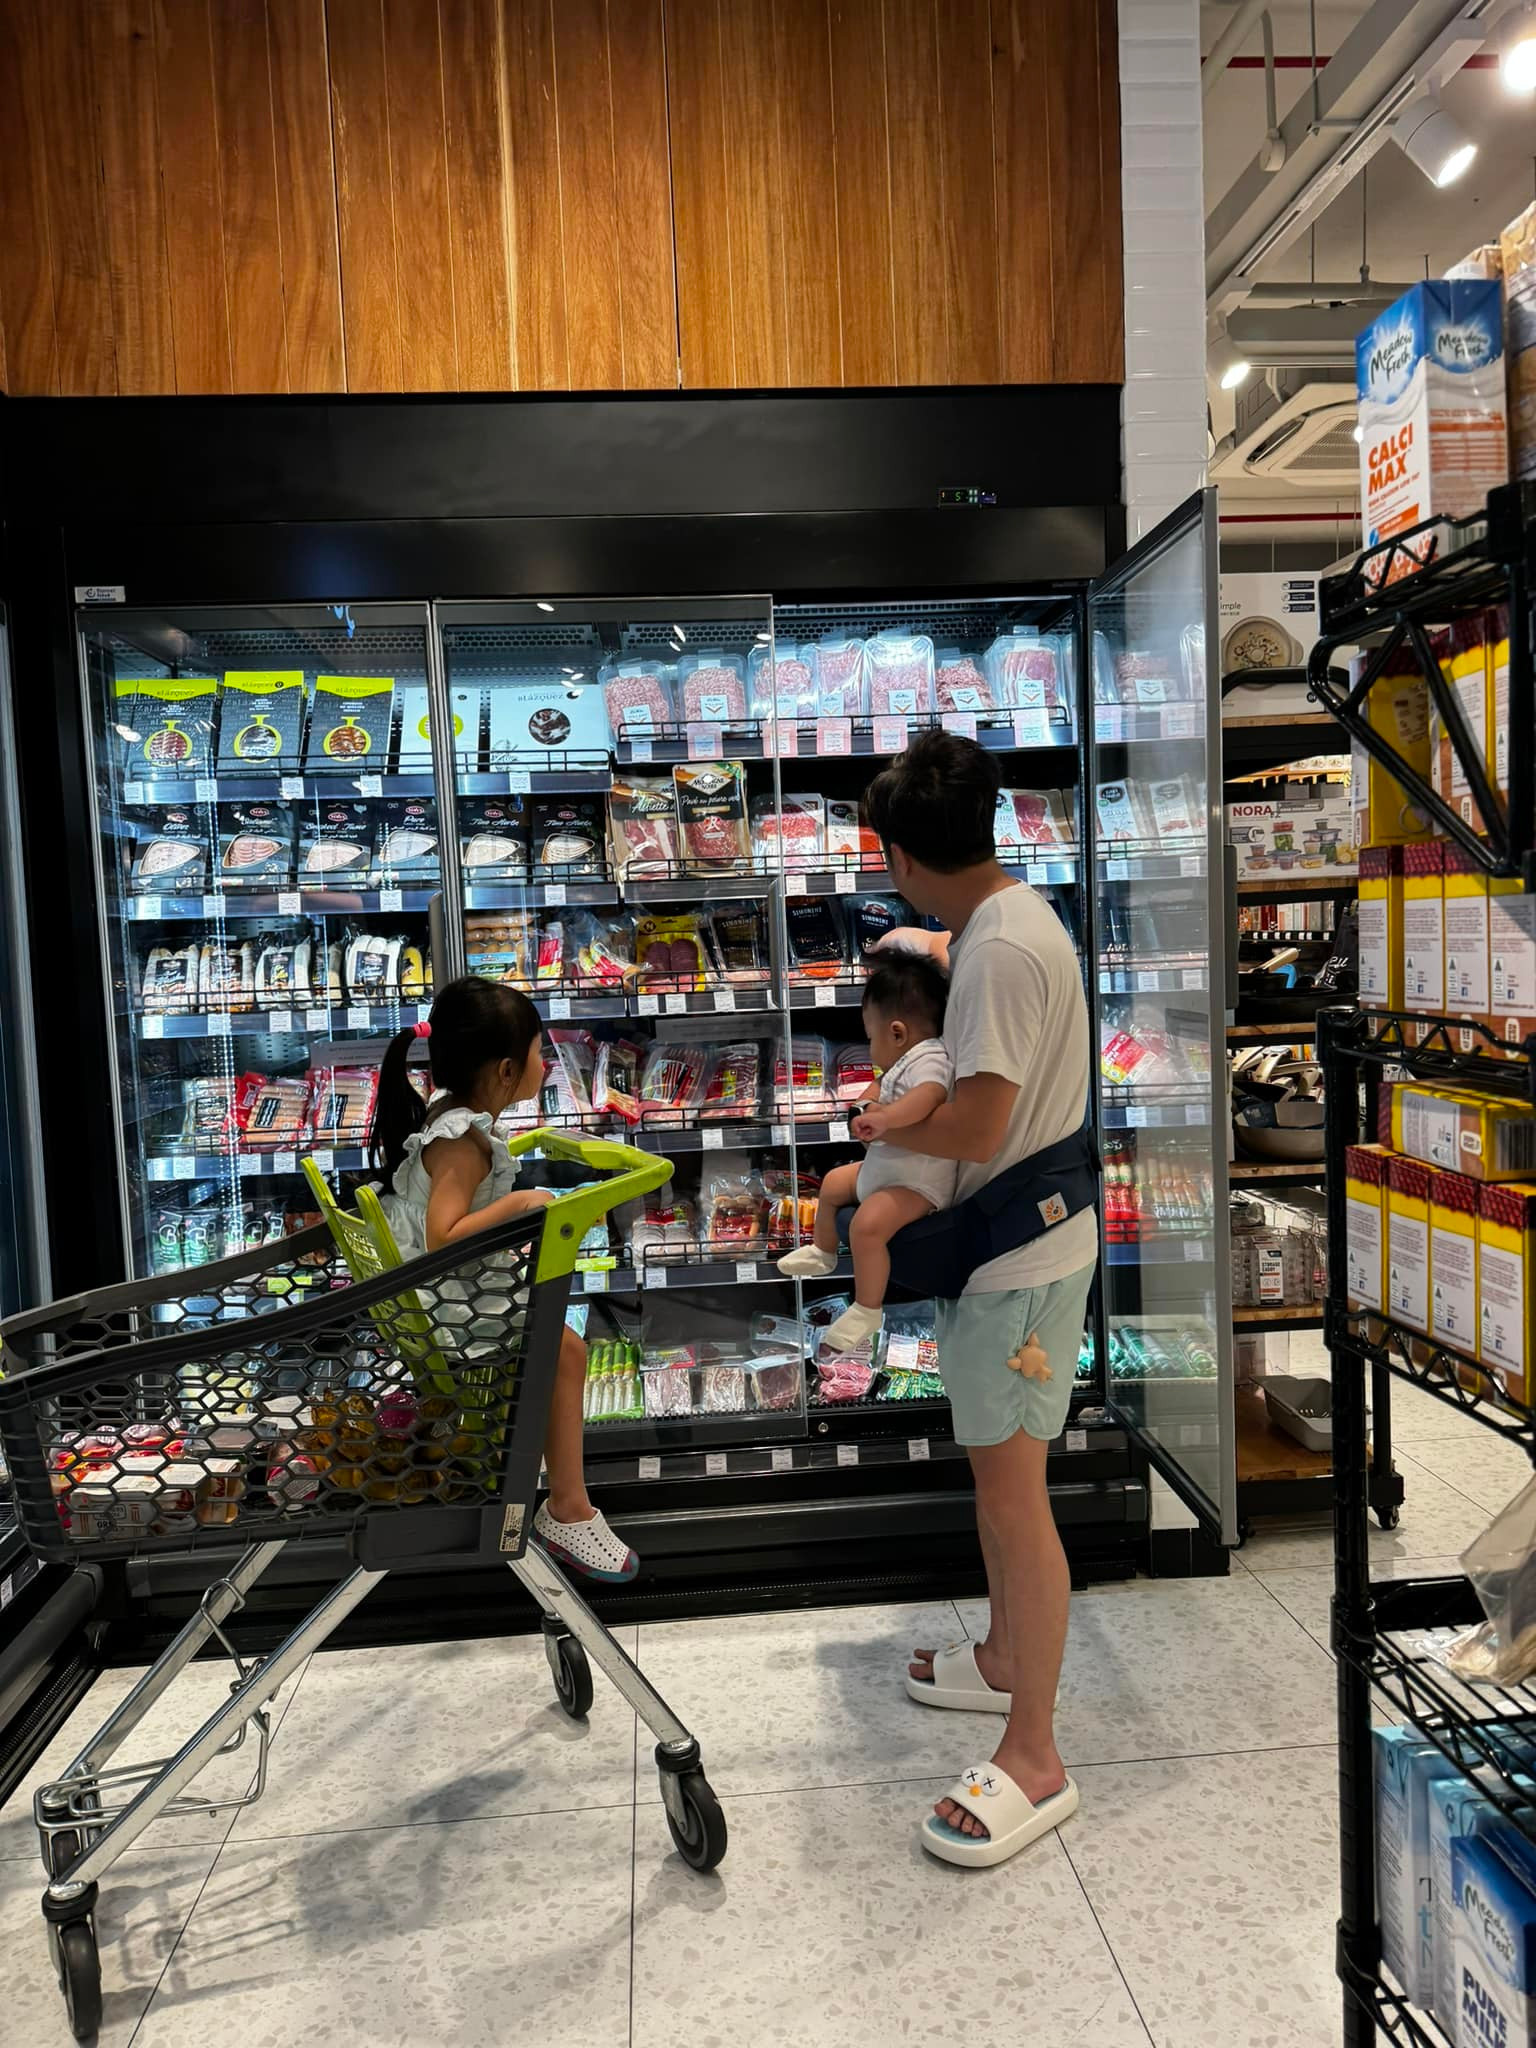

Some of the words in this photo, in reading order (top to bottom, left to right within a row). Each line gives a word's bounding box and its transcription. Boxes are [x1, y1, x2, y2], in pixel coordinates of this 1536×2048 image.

[1368, 421, 1413, 471] CALCI
[1368, 452, 1407, 497] MAX
[1220, 602, 1241, 611] imple
[1232, 801, 1274, 817] NORA
[1462, 1966, 1508, 2041] PURE
